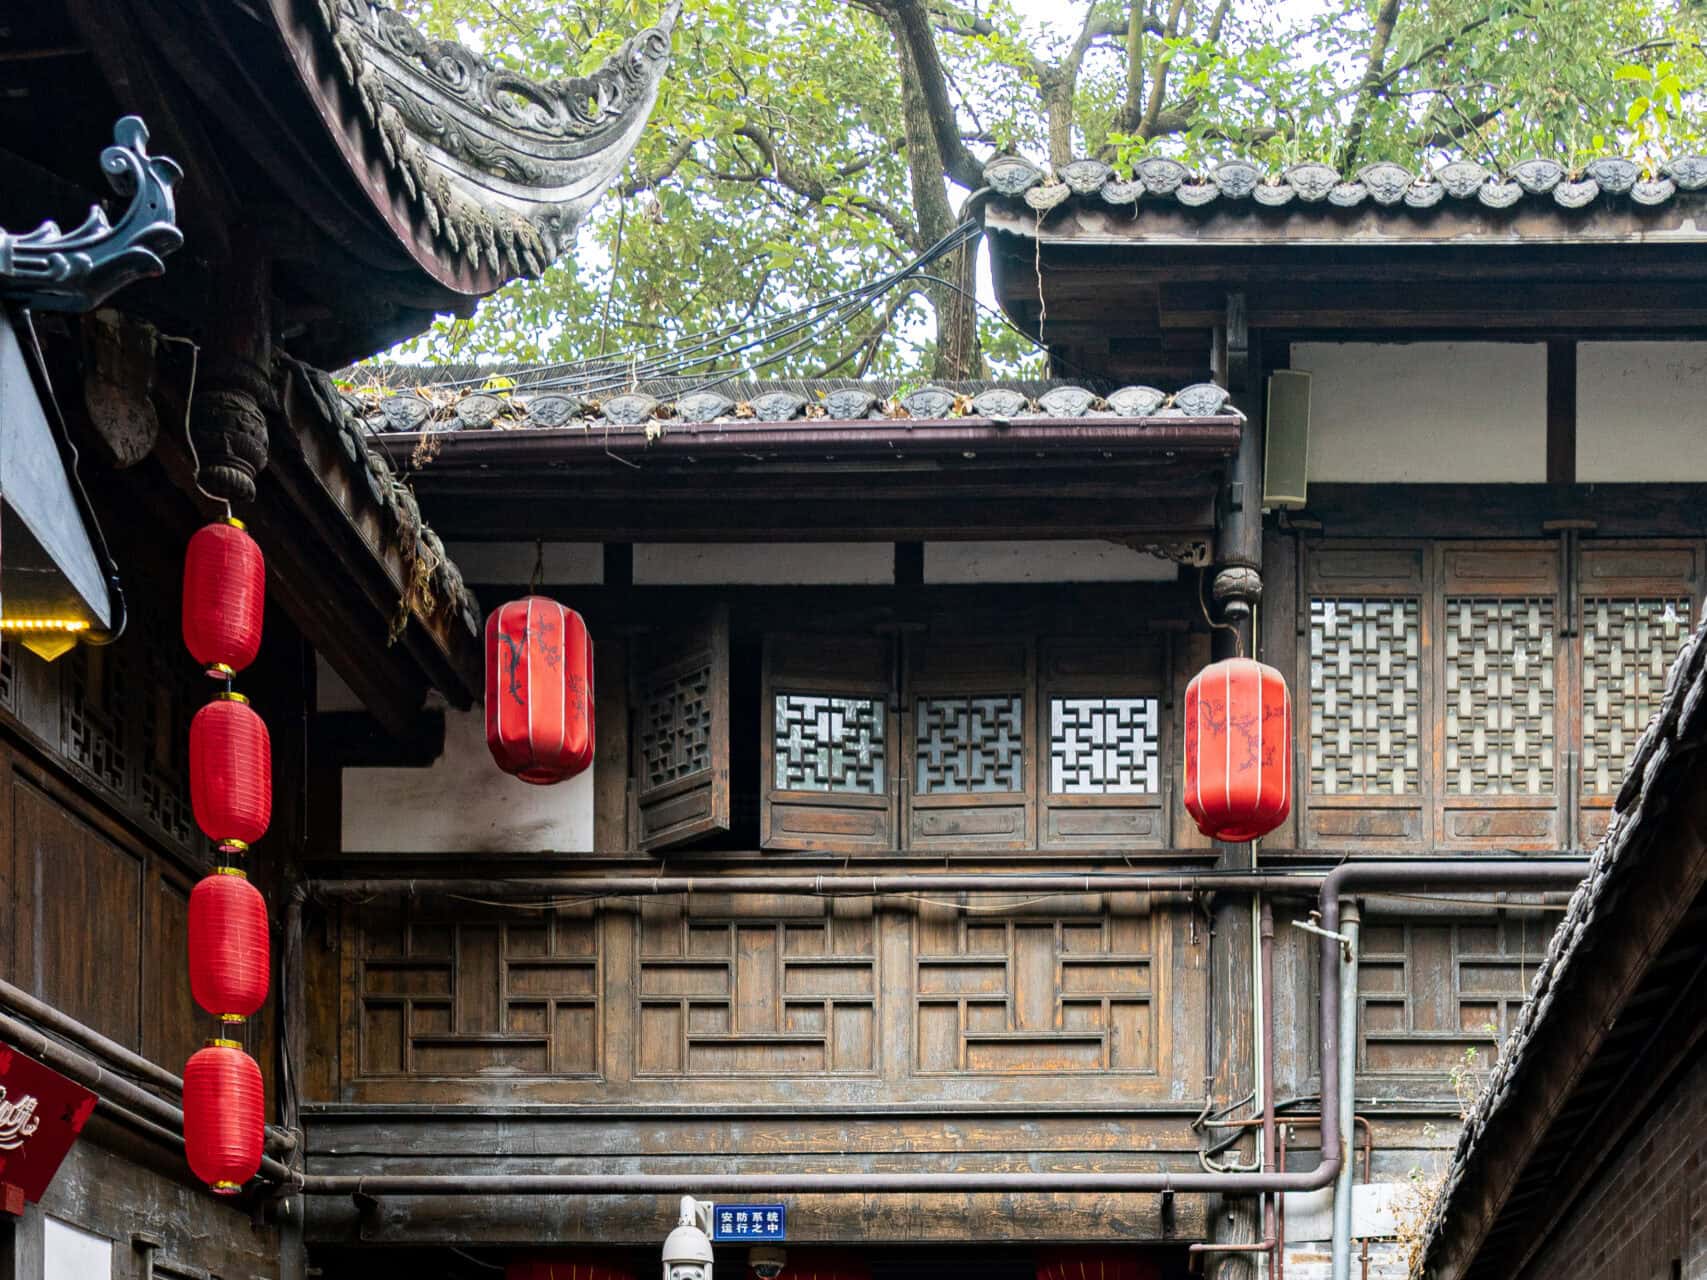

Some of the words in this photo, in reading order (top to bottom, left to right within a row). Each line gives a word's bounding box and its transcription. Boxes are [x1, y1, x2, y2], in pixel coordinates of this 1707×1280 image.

[721, 1212, 779, 1222] 安防系统
[721, 1223, 779, 1234] 运行之中
